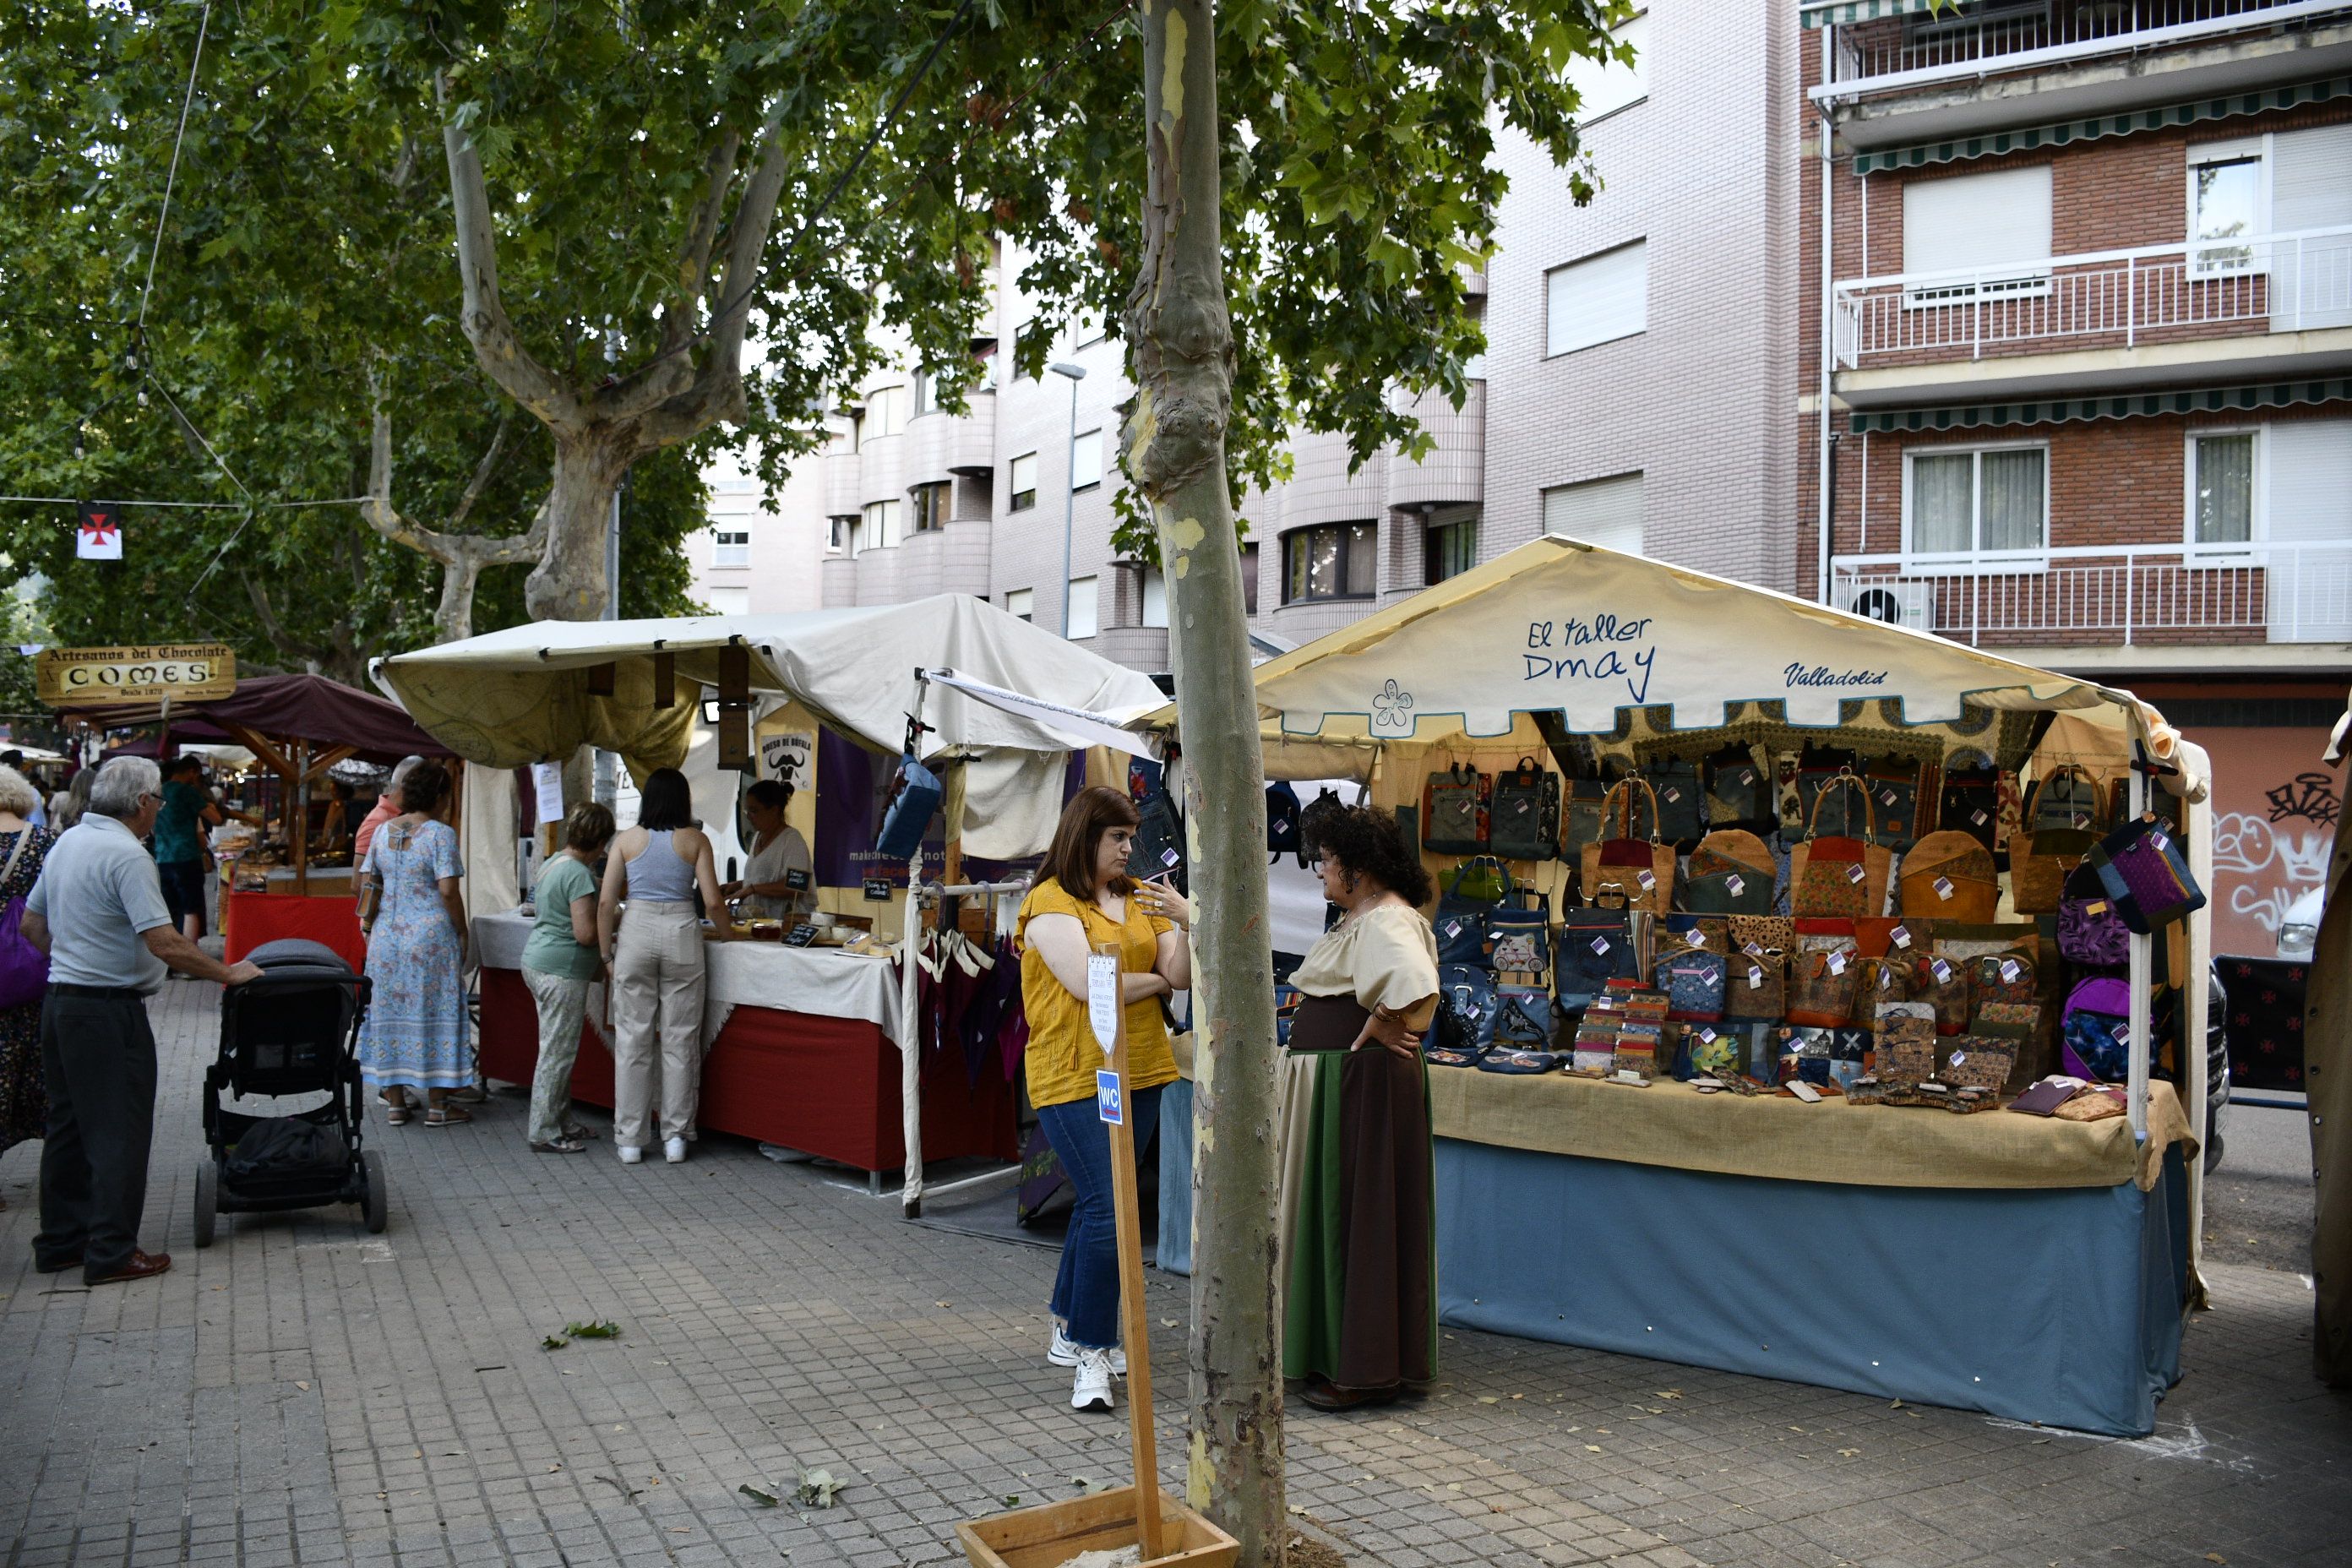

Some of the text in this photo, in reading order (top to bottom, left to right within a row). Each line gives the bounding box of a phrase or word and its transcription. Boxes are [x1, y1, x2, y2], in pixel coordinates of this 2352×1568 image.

[1527, 614, 1652, 648] El taller
[48, 646, 227, 662] Artesanos del Chocolate
[1522, 645, 1655, 703] Dmay
[1783, 662, 1888, 688] Valladolid
[762, 740, 781, 754] QUESO
[782, 738, 789, 746] DE
[923, 850, 945, 861] not
[1099, 1086, 1119, 1108] WC
